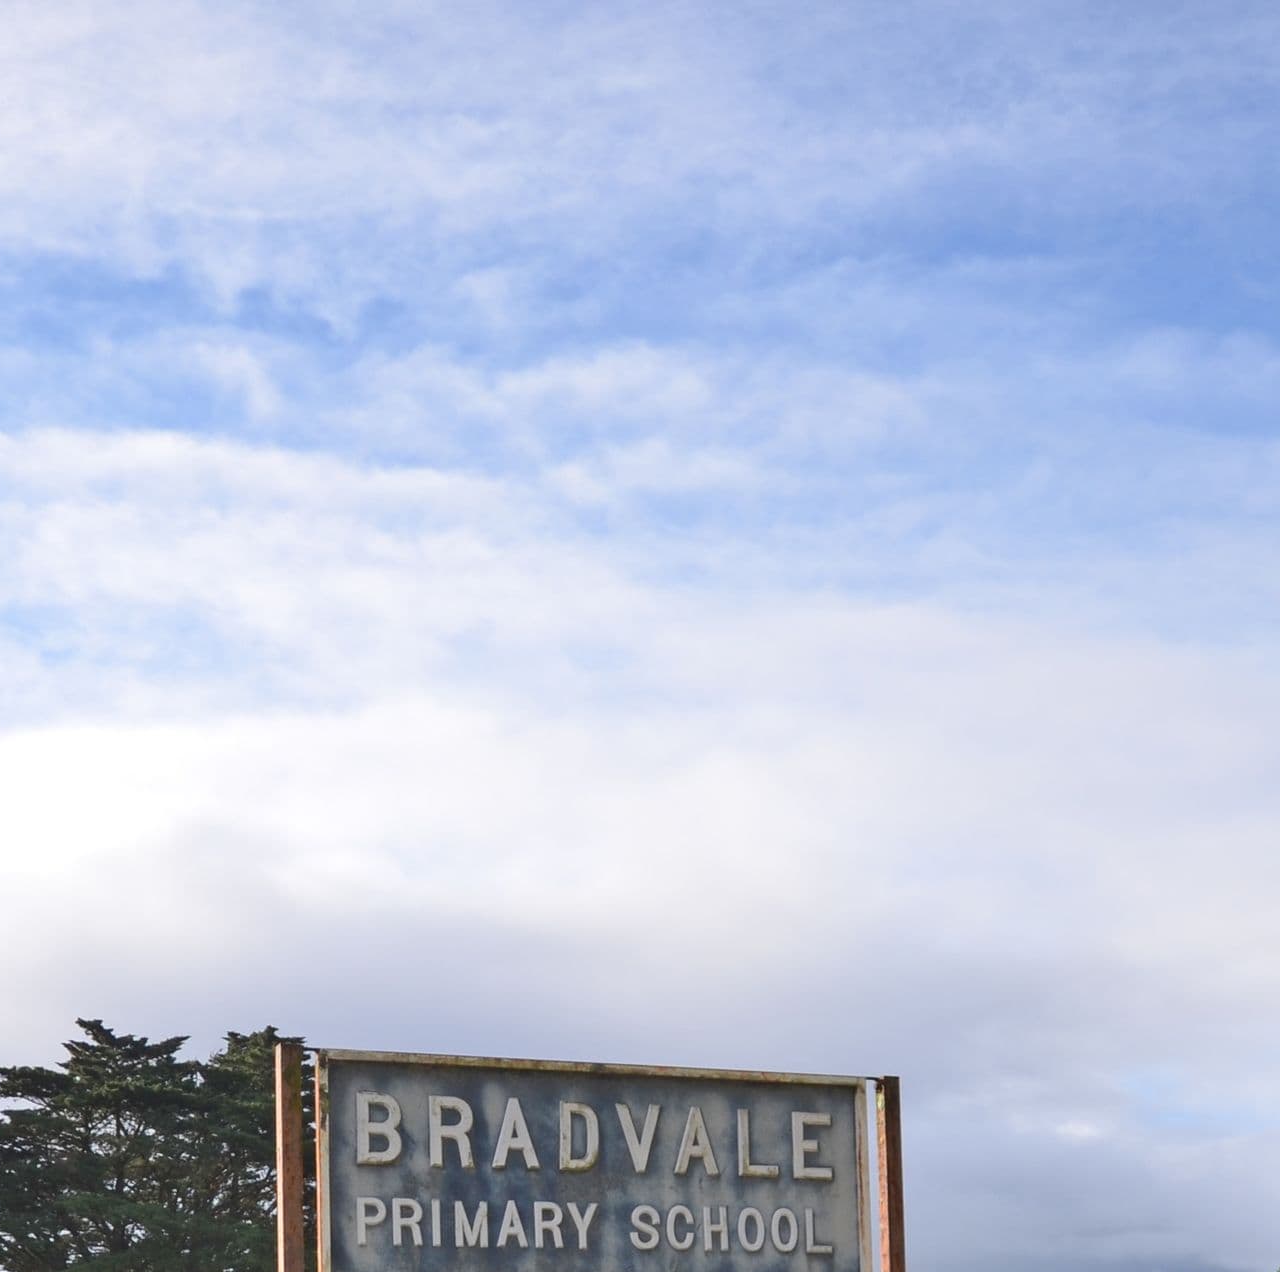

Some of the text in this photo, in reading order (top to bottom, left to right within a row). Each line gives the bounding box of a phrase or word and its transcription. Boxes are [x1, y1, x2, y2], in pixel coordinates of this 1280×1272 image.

[355, 1090, 835, 1181] BRADVALE
[356, 1197, 834, 1254] PRIMARY SCHOOL
